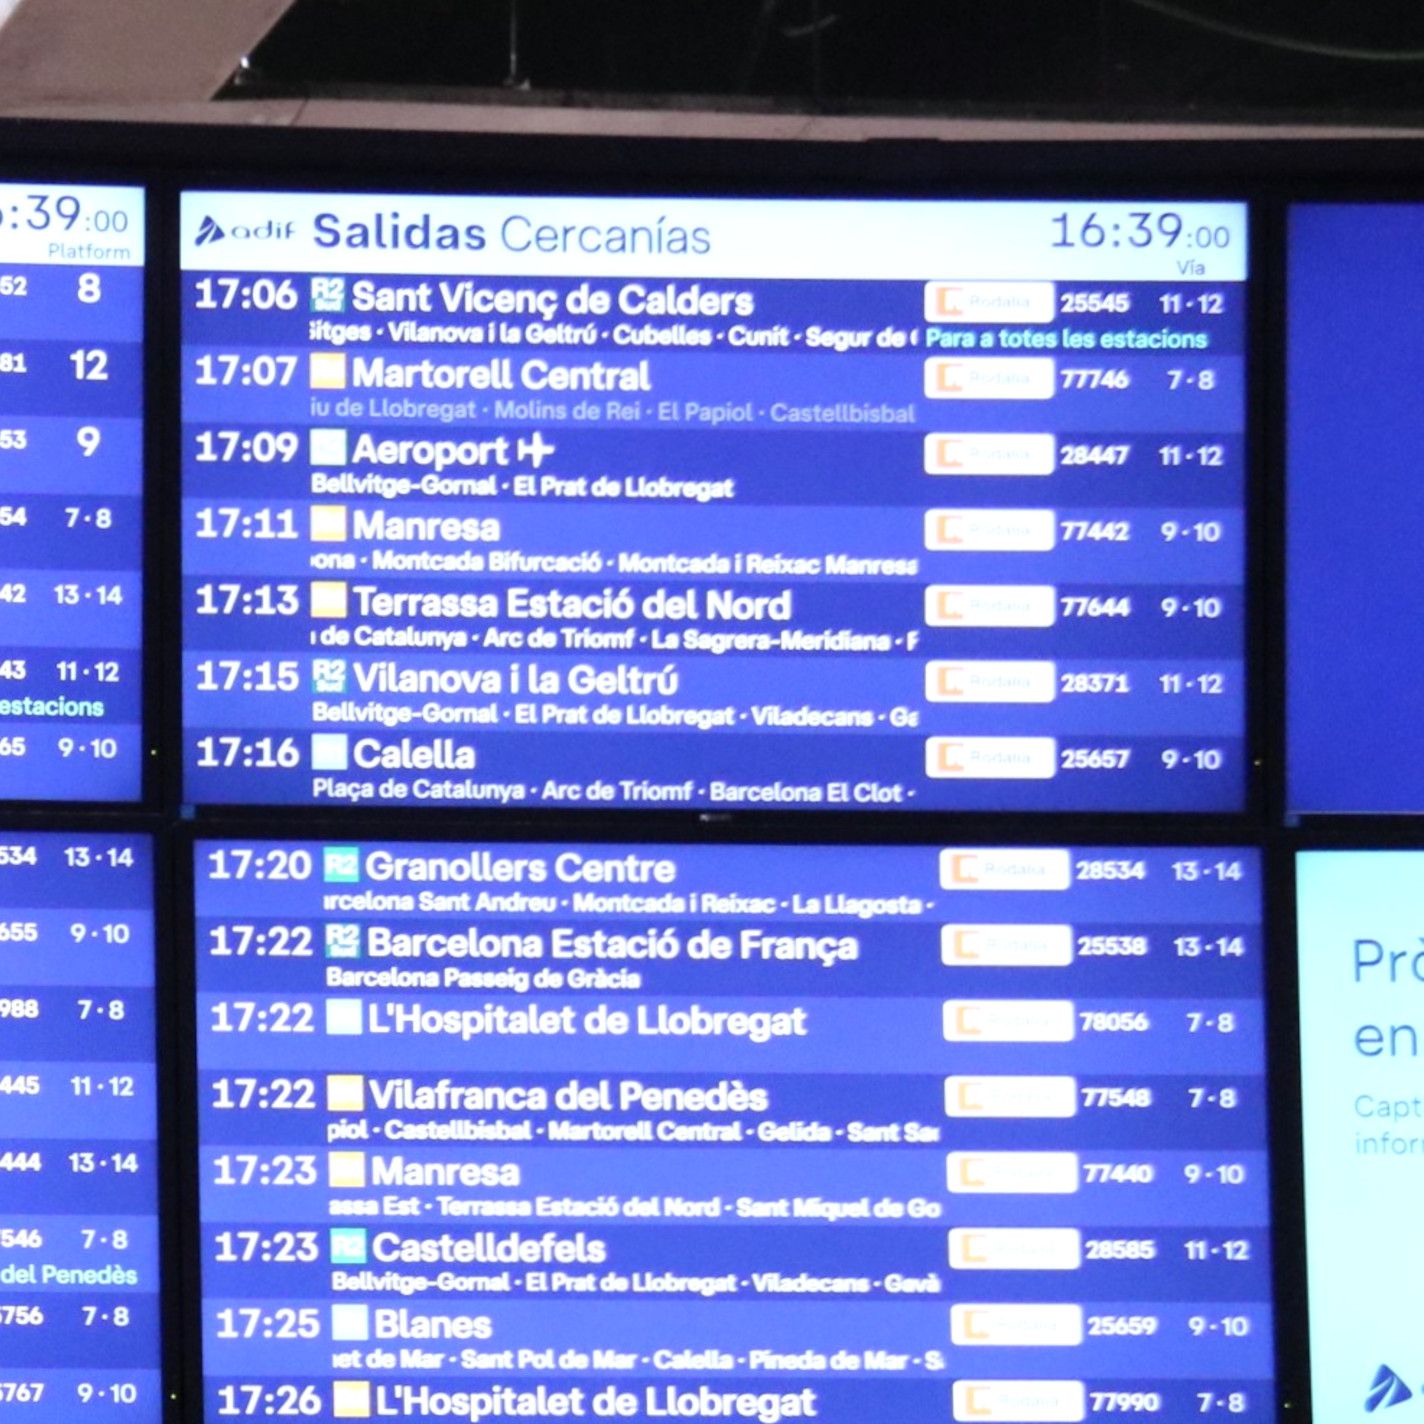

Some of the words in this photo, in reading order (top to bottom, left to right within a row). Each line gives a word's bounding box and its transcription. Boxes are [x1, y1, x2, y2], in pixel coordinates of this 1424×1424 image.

[313, 211, 487, 252] Salidas
[500, 214, 711, 255] Cercanías
[48, 242, 131, 259] Platform
[78, 273, 101, 304] 8
[70, 349, 108, 381] 12
[196, 354, 298, 386] 17:07
[356, 357, 514, 390] Martorell
[520, 358, 651, 391] Central
[1061, 369, 1129, 389] 77746
[76, 426, 101, 457] 9
[196, 431, 298, 462] 17:09
[356, 433, 509, 471] Aeroport
[196, 507, 299, 539] 17:11
[356, 509, 501, 542] Manresa
[196, 584, 299, 615] 17:13
[356, 586, 498, 618] Terrassa
[507, 587, 634, 619] Estació
[642, 589, 698, 620] del
[706, 590, 791, 620] Nord
[196, 660, 300, 692] 17:15
[356, 661, 502, 694] Vilanova
[510, 663, 520, 694] i
[528, 663, 560, 695] la
[567, 664, 679, 695] Geltrú
[198, 737, 299, 767] 17:16
[357, 738, 475, 770] Calella
[313, 778, 374, 802] Plaça
[378, 778, 408, 798] de
[412, 779, 525, 803] Catalunya
[542, 780, 580, 800] Arc
[586, 780, 615, 800] de
[620, 780, 692, 801] Triomf
[710, 781, 822, 802] Barcelona
[827, 783, 849, 802] El
[853, 783, 902, 803] Clot
[209, 849, 312, 880] 17:20
[368, 850, 547, 882] Granollers
[555, 852, 676, 883] Centre
[212, 1078, 316, 1109] 17:22
[372, 1079, 548, 1111] Vilafranca
[555, 1079, 612, 1111] del
[620, 1080, 769, 1112] Penedès
[1081, 1087, 1151, 1107] 77548
[1355, 1131, 1424, 1155] infor
[0, 1264, 37, 1285] del
[41, 1263, 138, 1285] Penedès
[217, 1307, 321, 1338] 17:25
[376, 1308, 493, 1340] Blanes
